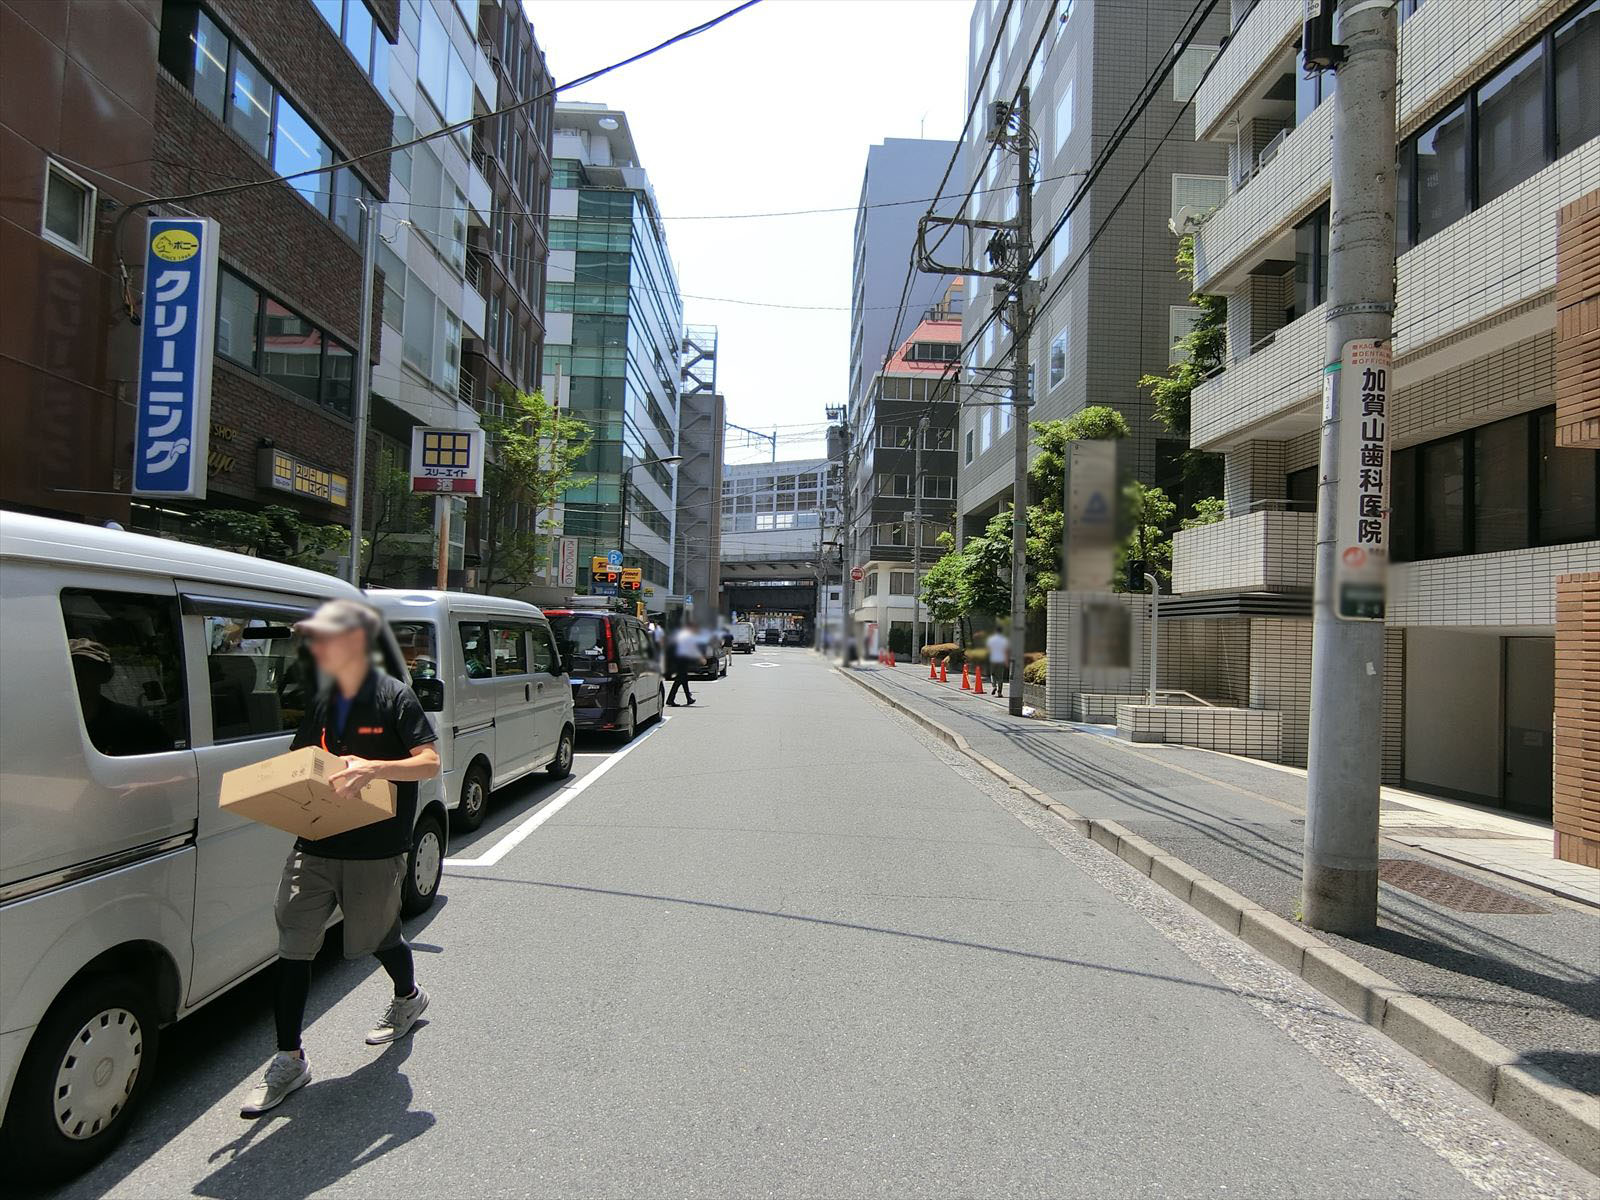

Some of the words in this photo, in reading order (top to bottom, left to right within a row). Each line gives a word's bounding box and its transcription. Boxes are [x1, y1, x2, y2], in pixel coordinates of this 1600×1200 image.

[172, 240, 198, 250] ポニー
[146, 270, 191, 473] クリーニング
[1358, 367, 1386, 544] 加賀山歯科医院
[424, 468, 468, 478] スリーエイト
[436, 479, 454, 492] 酒
[608, 573, 617, 582] P
[632, 582, 640, 590] P
